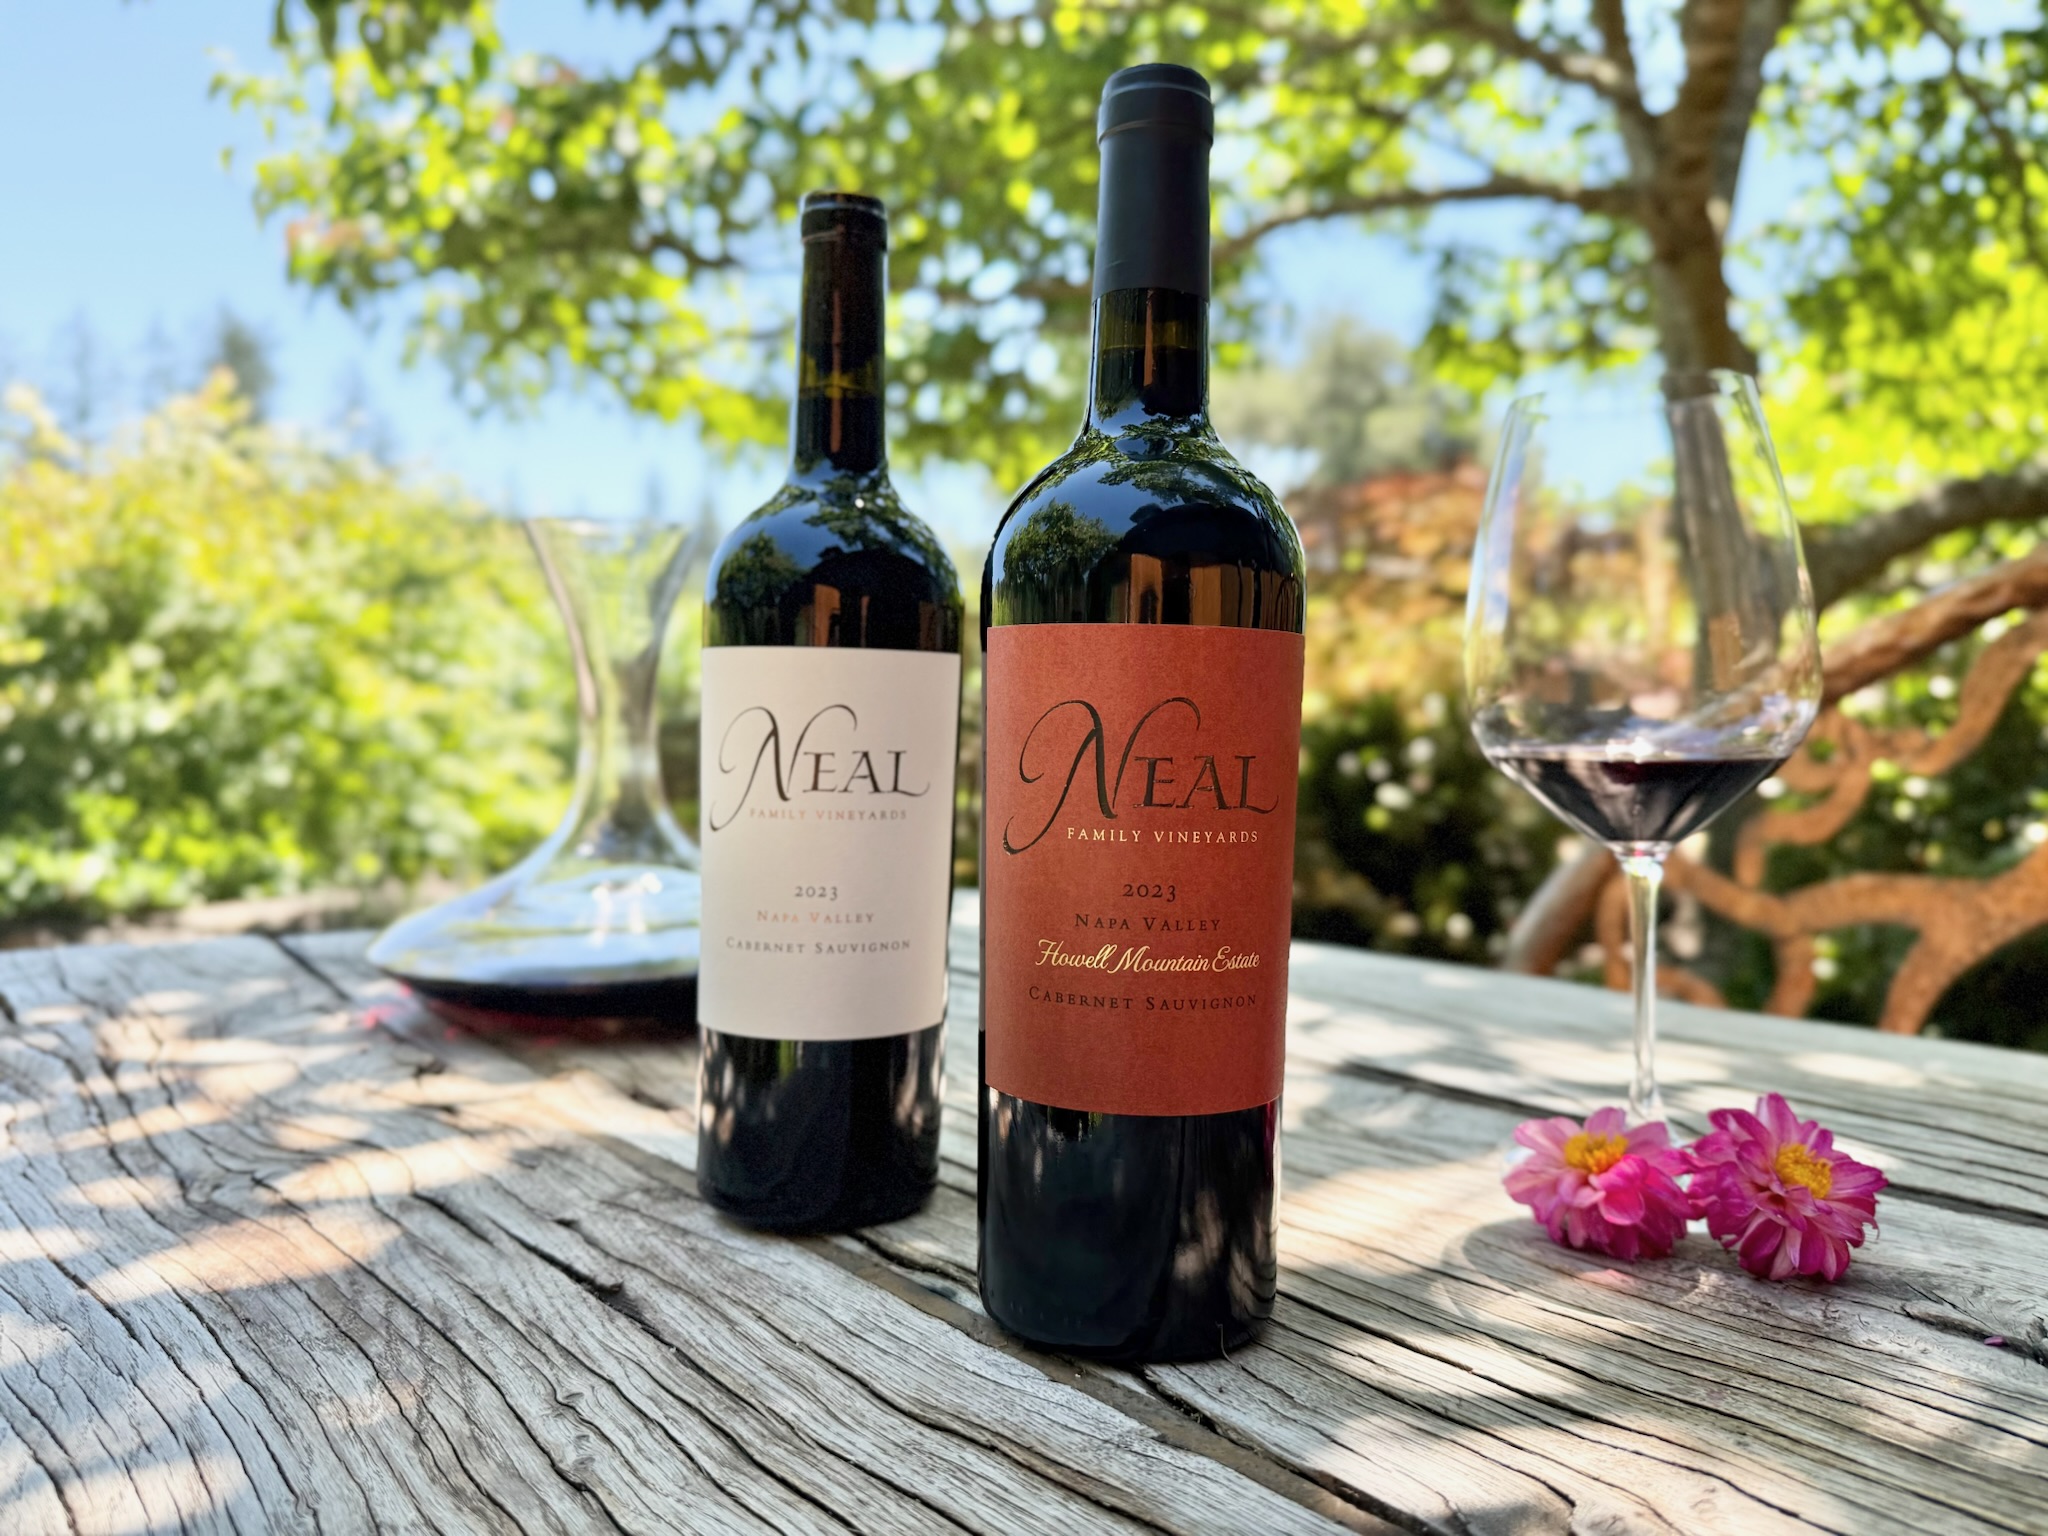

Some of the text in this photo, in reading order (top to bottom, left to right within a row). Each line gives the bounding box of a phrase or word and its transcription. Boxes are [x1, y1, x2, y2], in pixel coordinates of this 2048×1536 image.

[710, 704, 930, 831] NEAL
[1003, 697, 1279, 855] NEAL
[750, 808, 907, 821] FAMILY VINEYARDS
[1067, 827, 1259, 843] FAMILY VINEYARDS
[794, 886, 838, 900] 2023
[1123, 883, 1176, 901] 2023
[757, 911, 875, 923] NAPA VALLEY
[1075, 913, 1221, 931] NAPA VALLEY
[726, 937, 910, 954] CABERNET SAUVIGNON
[1035, 939, 1260, 974] Howell Mountain Estate
[1029, 986, 1256, 1010] CABERNET SAUVIGNON
